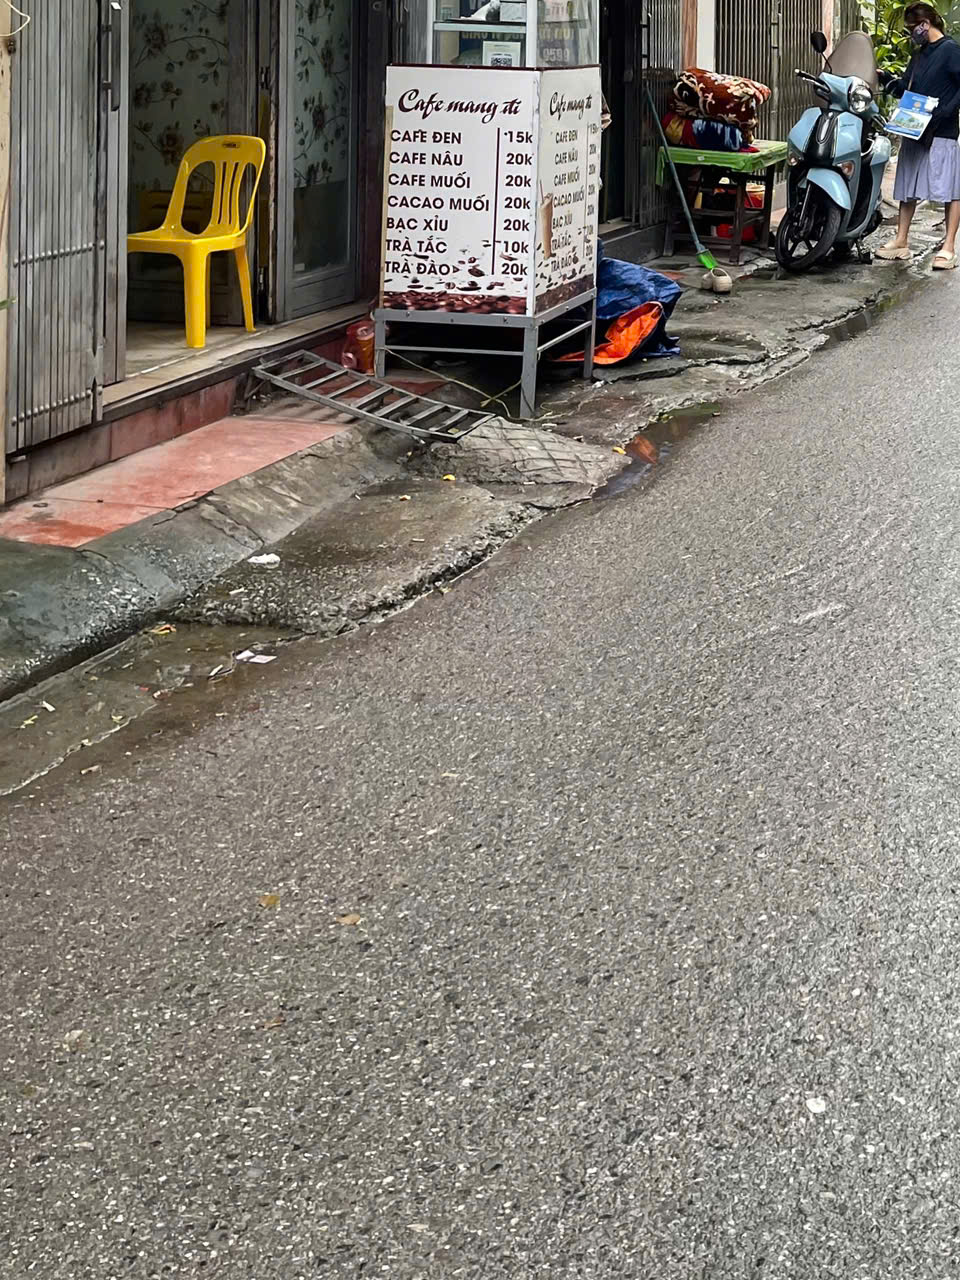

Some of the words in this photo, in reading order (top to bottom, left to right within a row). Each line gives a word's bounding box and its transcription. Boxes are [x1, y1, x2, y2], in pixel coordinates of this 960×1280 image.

[398, 88, 445, 120] Cafe
[446, 99, 498, 124] mang
[390, 129, 427, 143] CAFE
[432, 131, 462, 144] ĐEN
[507, 130, 533, 144] 15k
[555, 131, 568, 144] CAFE
[389, 151, 427, 165] CAFE
[431, 150, 463, 166] NÂU
[506, 152, 533, 165] 20k
[555, 151, 568, 165] CAFE
[388, 173, 426, 187] CAFE
[430, 171, 471, 188] MUỐI
[505, 174, 532, 187] 20k
[387, 195, 445, 209] CACAO
[450, 194, 489, 211] MUỐI
[504, 196, 531, 209] 20k
[386, 217, 418, 233] BẠC
[422, 215, 449, 232] XỈU
[503, 219, 530, 232] 20k
[385, 236, 412, 252] TRÀ
[417, 235, 448, 253] TẮC
[503, 241, 529, 254] 10k
[384, 258, 411, 274] TRÀ
[417, 260, 450, 275] ĐÀO
[501, 263, 528, 276] 20k
